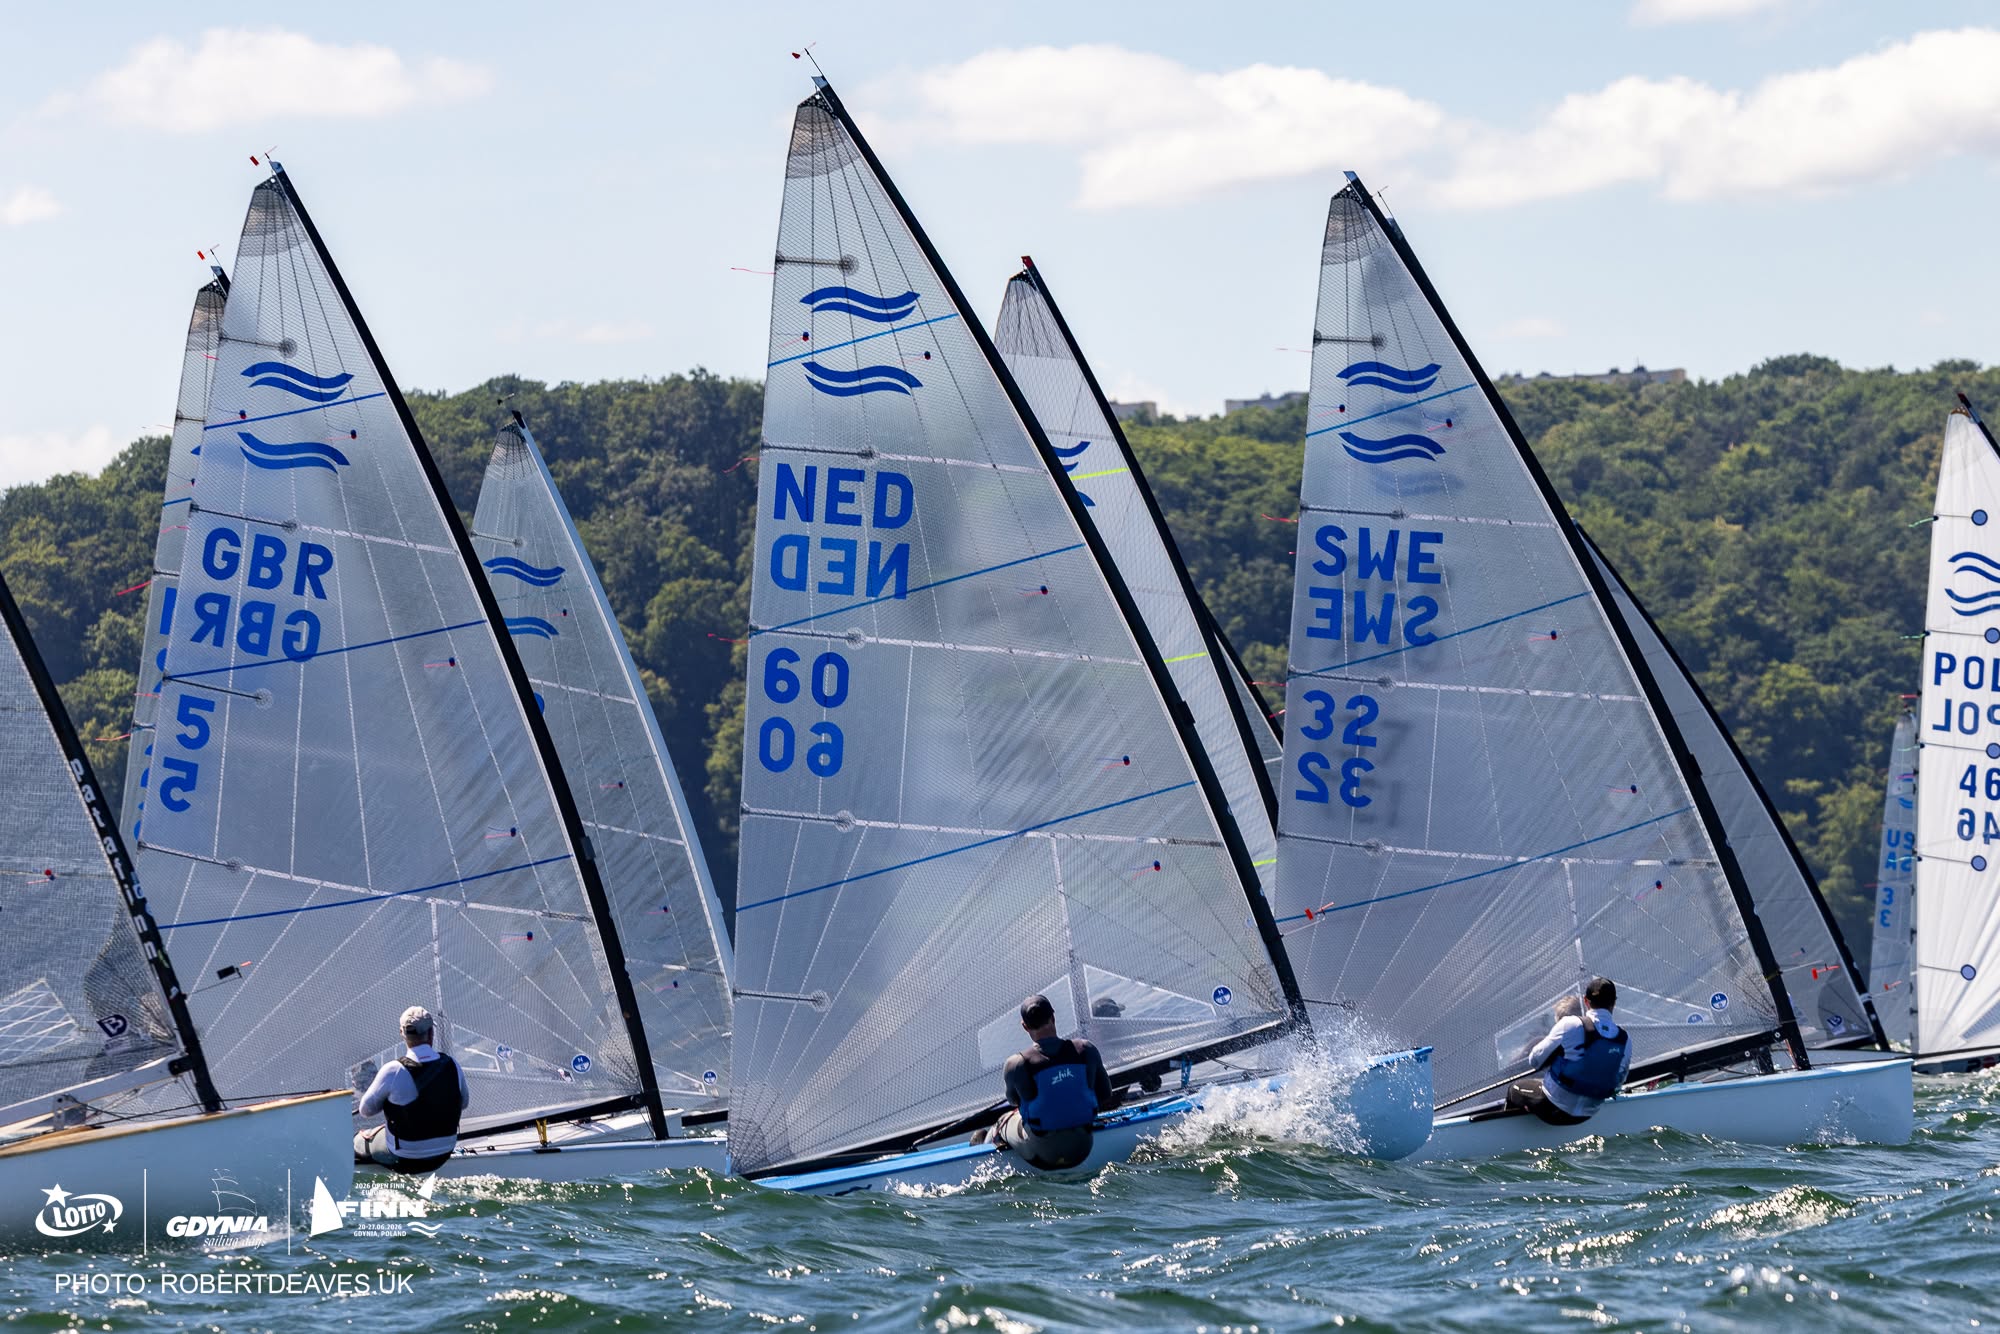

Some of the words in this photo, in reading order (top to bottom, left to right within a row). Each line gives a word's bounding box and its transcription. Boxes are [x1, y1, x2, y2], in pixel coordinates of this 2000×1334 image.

[774, 463, 914, 530] NED
[202, 527, 334, 600] GBR
[1312, 524, 1444, 585] SWE
[764, 647, 850, 709] 60
[176, 693, 216, 751] 5
[1301, 689, 1379, 748] 32
[1959, 764, 2000, 801] 46
[1887, 828, 1915, 850] US
[1051, 1067, 1075, 1085] zhik
